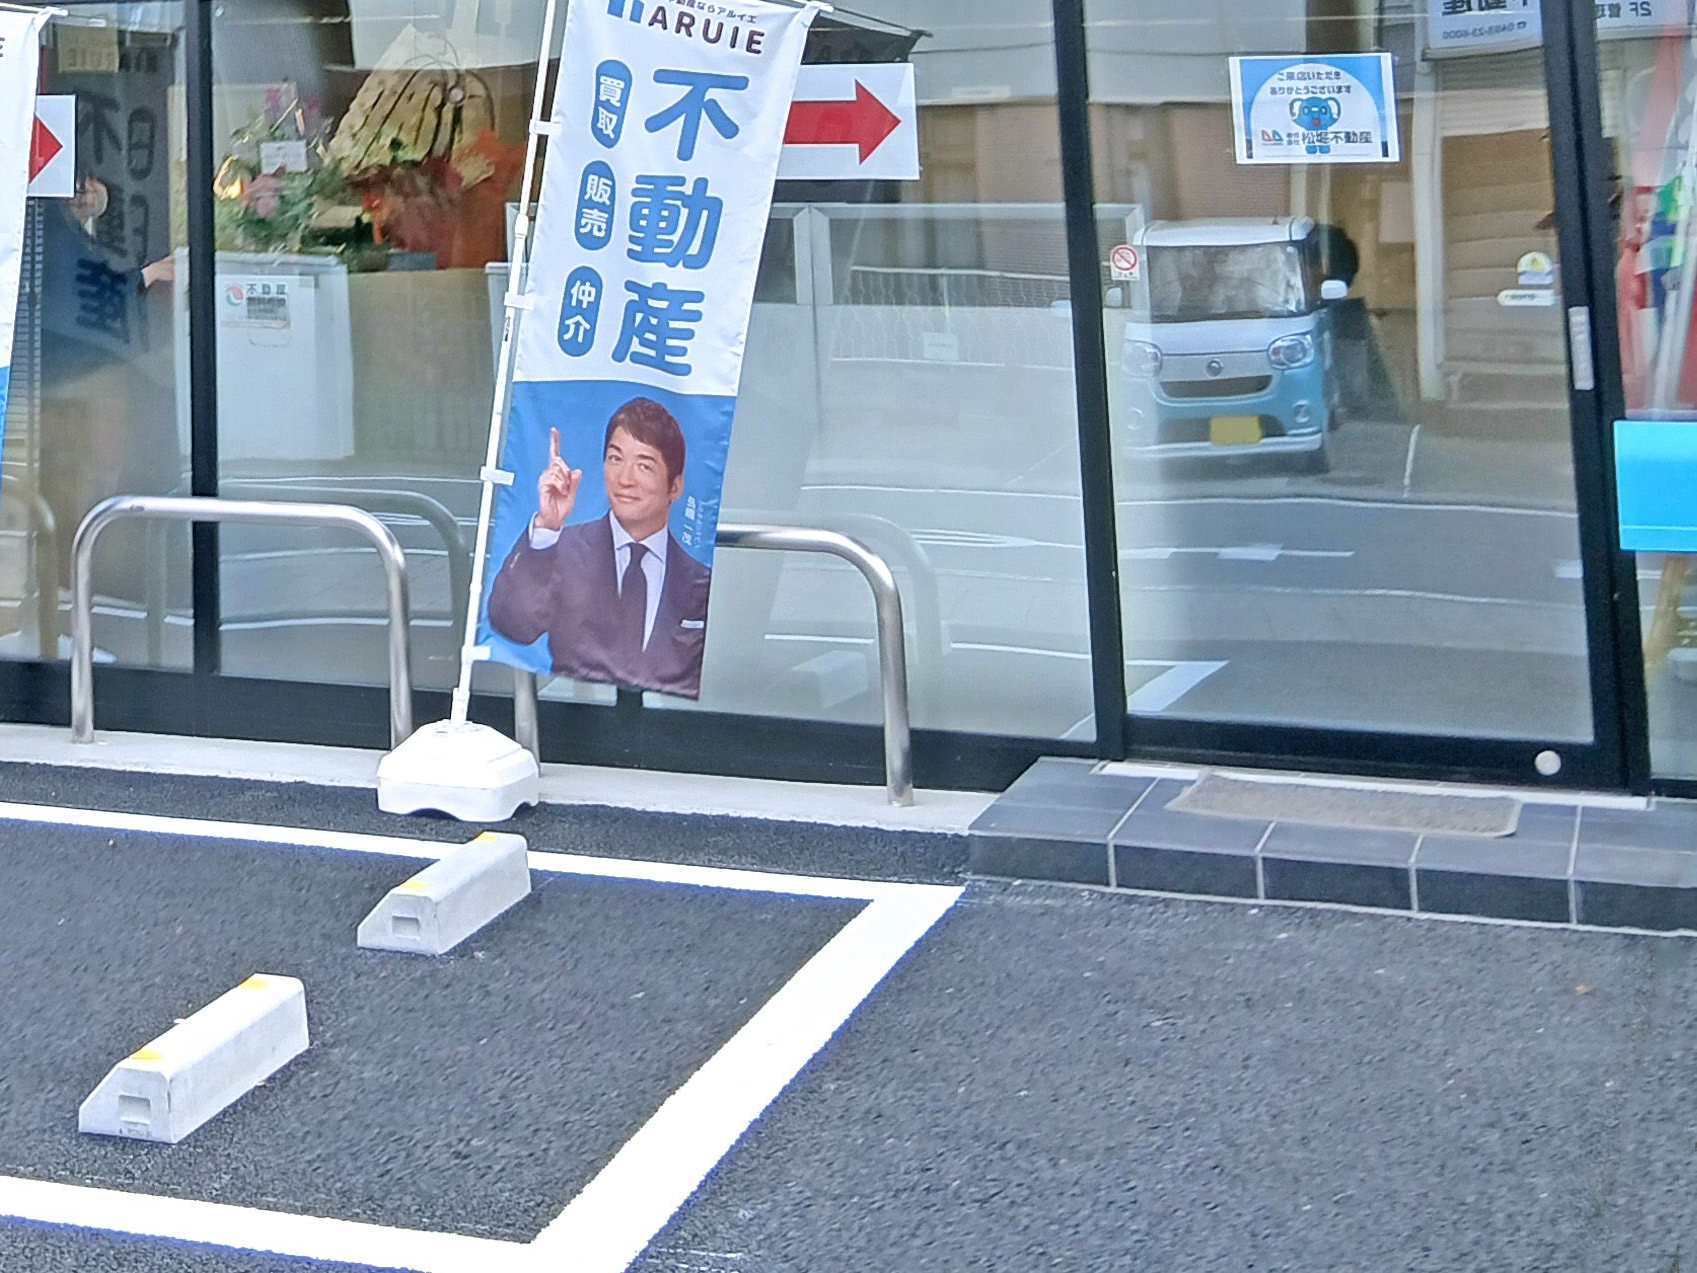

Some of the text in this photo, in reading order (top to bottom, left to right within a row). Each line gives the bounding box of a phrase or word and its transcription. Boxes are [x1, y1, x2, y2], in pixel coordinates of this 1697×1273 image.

[648, 5, 766, 55] ARUIE
[595, 75, 626, 140] 買取
[1269, 84, 1352, 96] ありがとうございます
[579, 173, 614, 239] 販売
[611, 68, 750, 378] 不動産
[562, 279, 597, 345] 仲介
